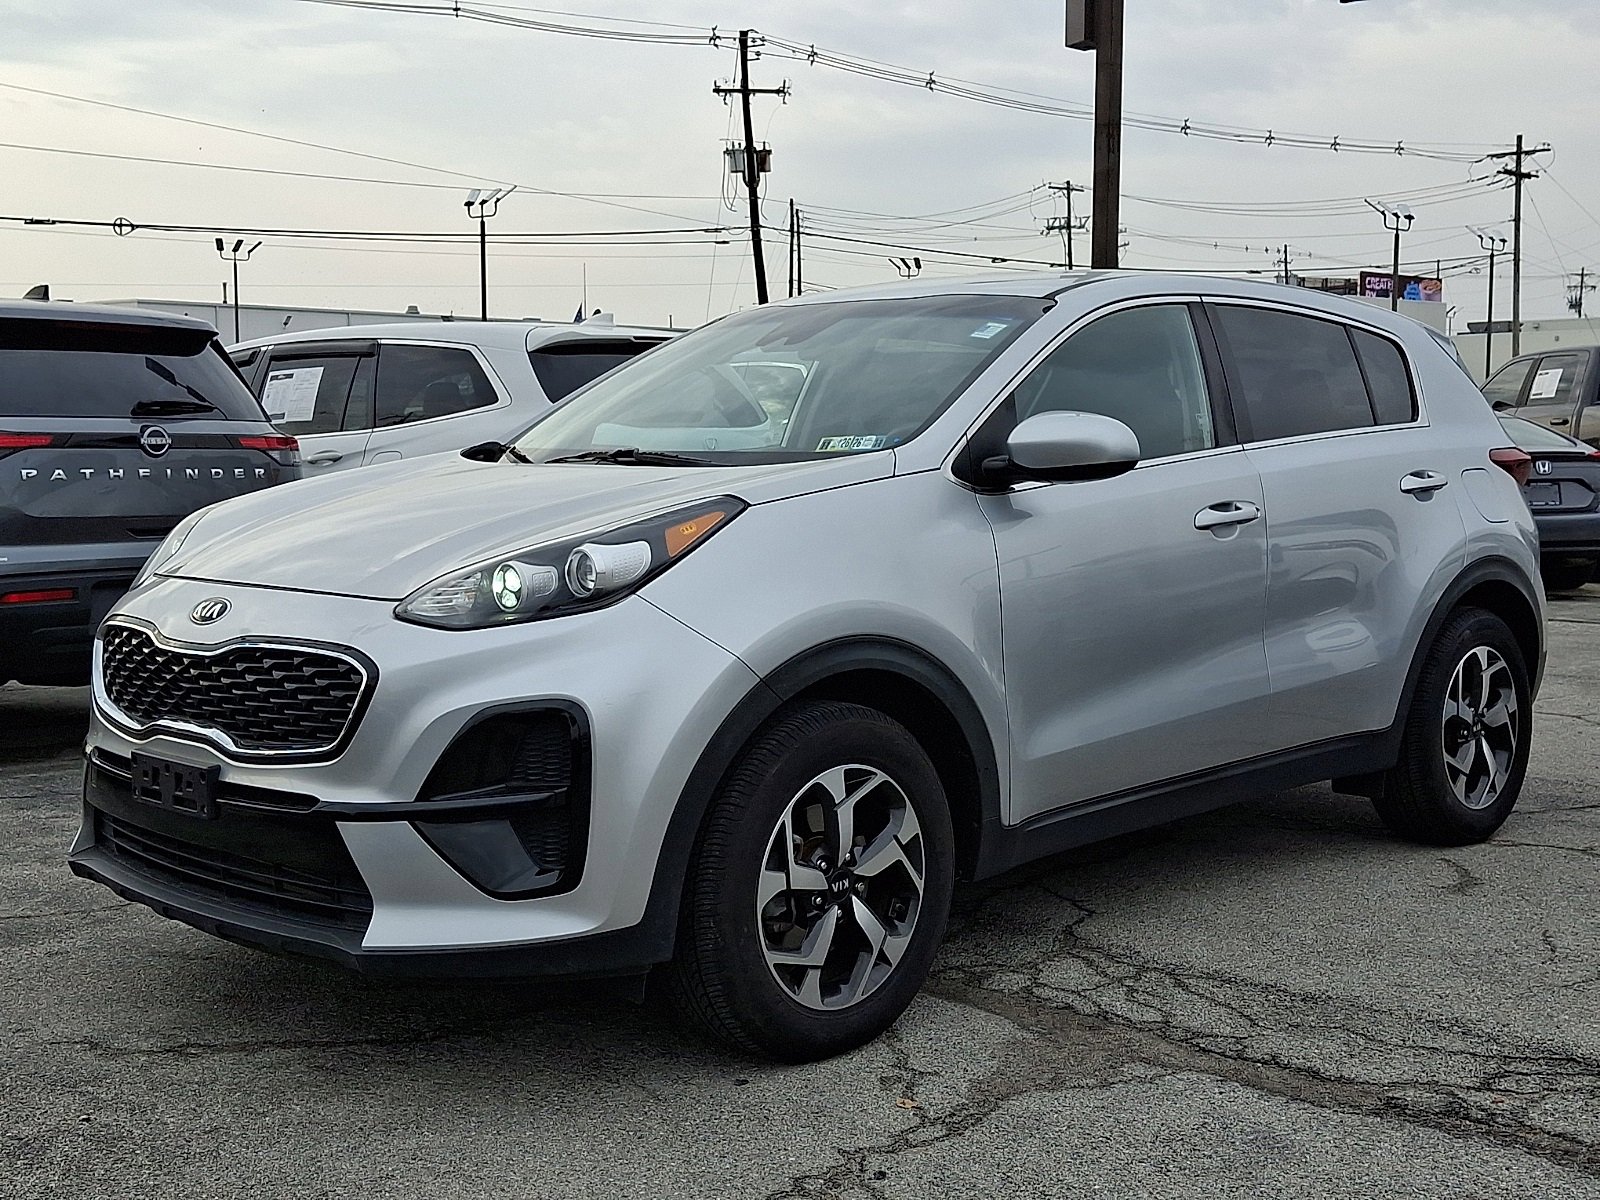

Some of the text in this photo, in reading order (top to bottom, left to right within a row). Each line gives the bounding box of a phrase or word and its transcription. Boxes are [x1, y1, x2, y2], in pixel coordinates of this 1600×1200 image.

[1365, 276, 1394, 290] CREATE
[140, 436, 172, 445] NISSAN
[20, 468, 266, 482] PATHFINDER
[192, 600, 224, 619] KIA
[831, 877, 850, 893] KIA
